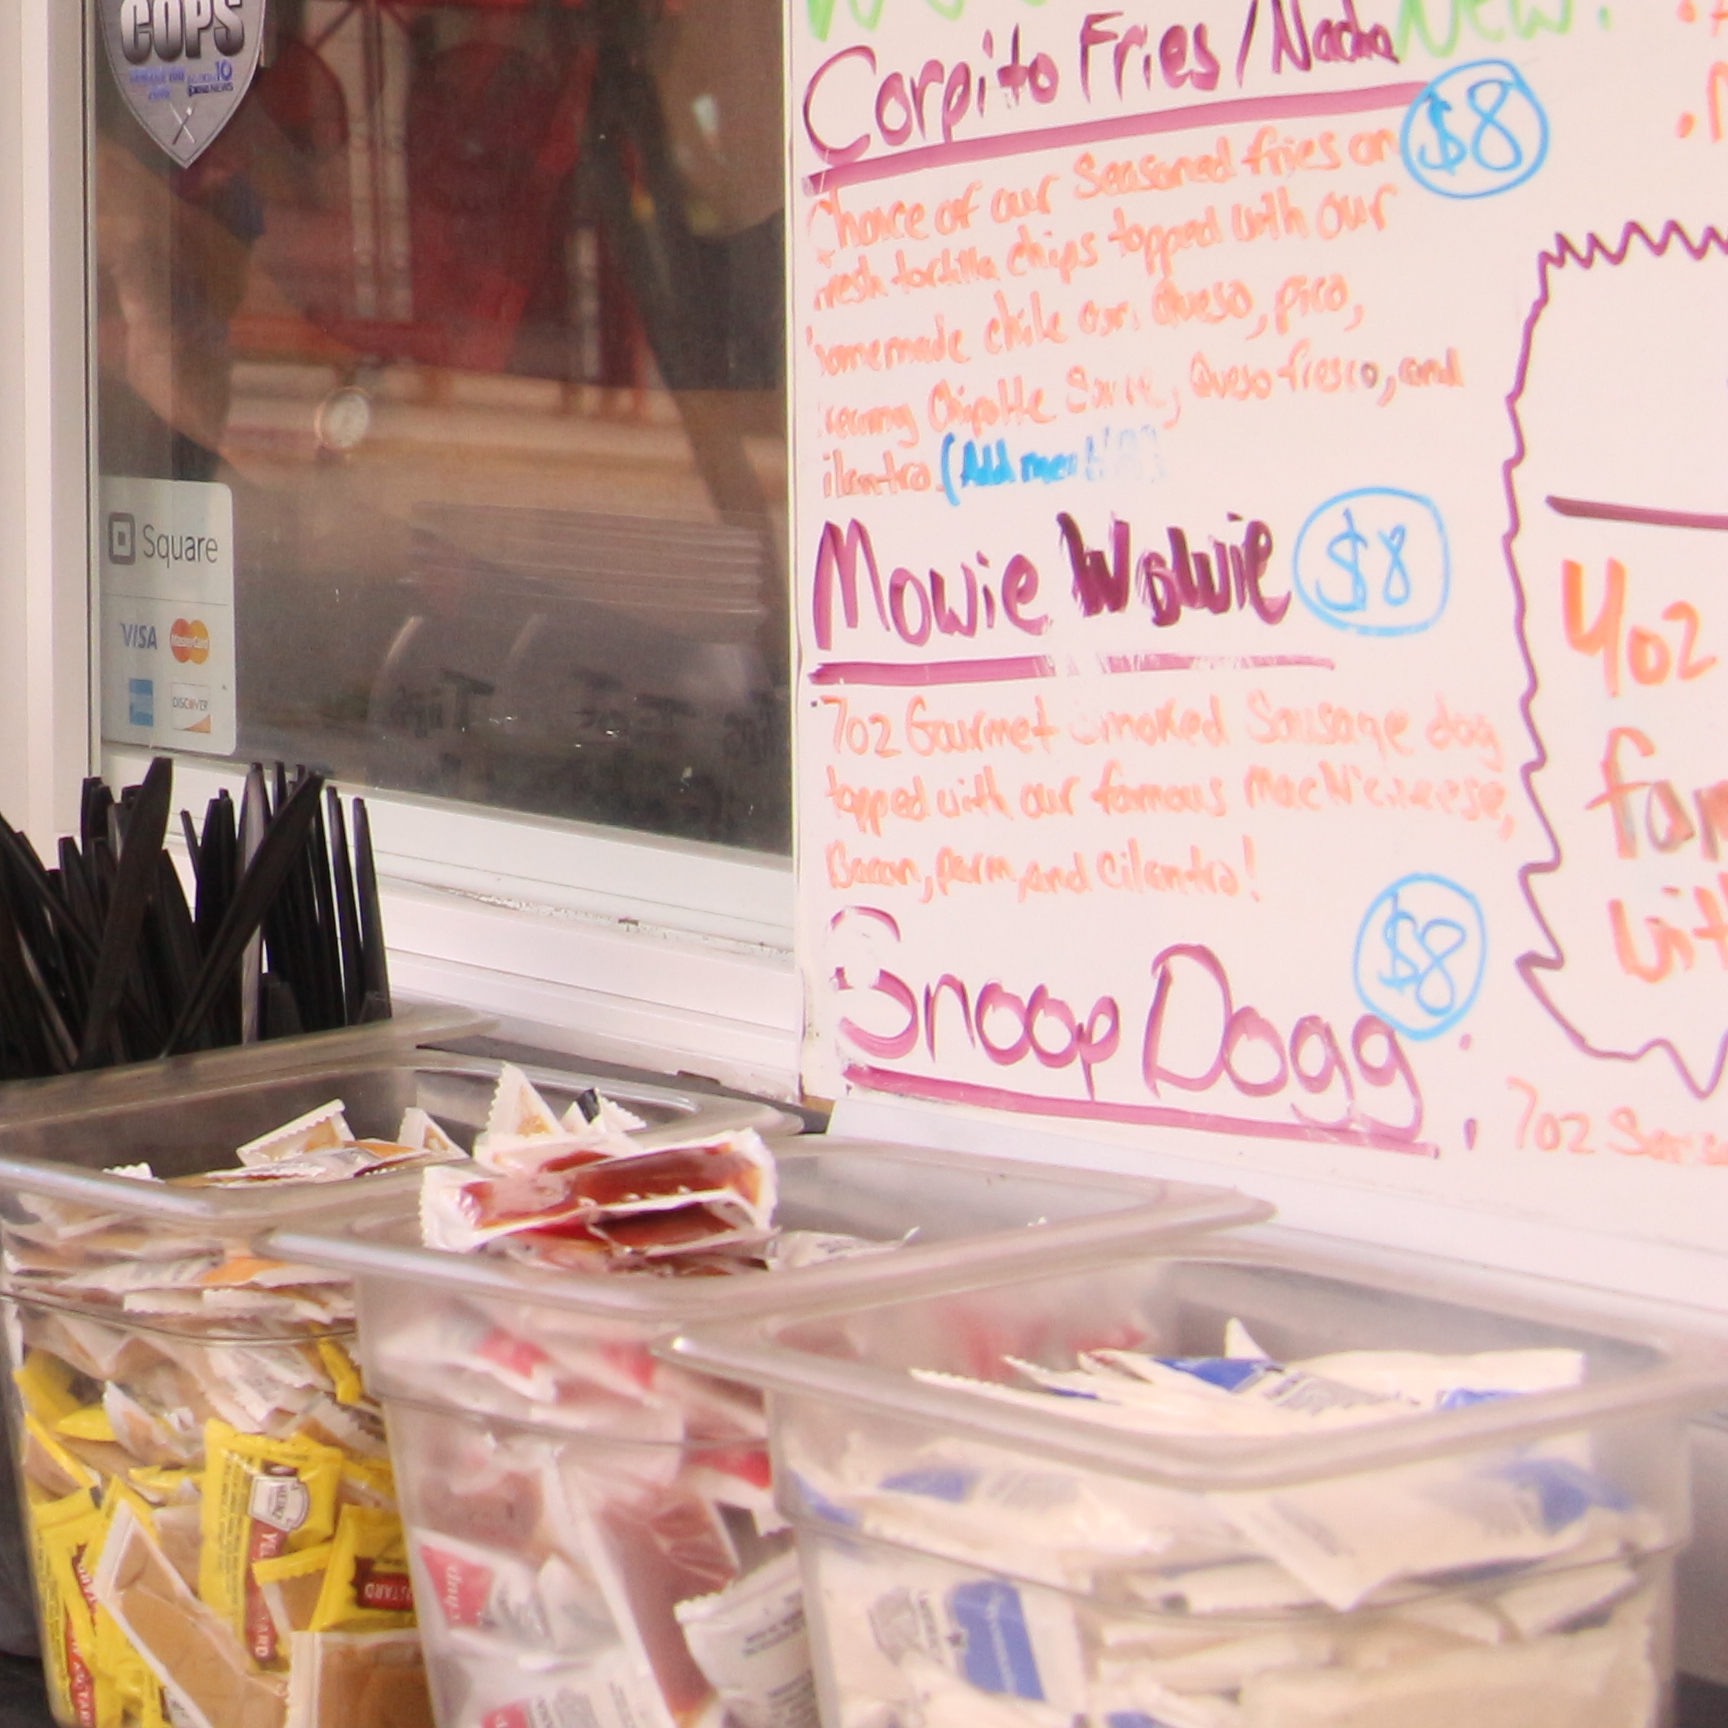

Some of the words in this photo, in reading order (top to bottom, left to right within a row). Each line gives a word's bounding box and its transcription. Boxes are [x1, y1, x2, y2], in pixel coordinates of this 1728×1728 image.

[1418, 76, 1524, 177] $8
[934, 182, 986, 234] of
[990, 173, 1061, 219] our
[1240, 126, 1342, 179] fries
[1005, 224, 1099, 284] chips
[1107, 203, 1224, 276] topped
[1233, 186, 1309, 242] with
[1314, 183, 1399, 239] our
[1398, 348, 1466, 390] and
[142, 523, 219, 569] Square
[1314, 507, 1411, 613] $8
[119, 622, 158, 651] VISA
[170, 634, 210, 649] MasterCard
[1560, 556, 1718, 698] 4oz
[172, 696, 209, 712] DISCOVER
[820, 695, 902, 759] 7oz
[904, 693, 1060, 753] Gourmet
[1425, 695, 1504, 771] dog
[823, 766, 930, 836] topped
[936, 763, 1015, 821] with
[1020, 774, 1079, 820] our
[1095, 762, 1229, 818] famous
[1379, 891, 1467, 1017] $8
[829, 905, 1121, 1100] Snoop
[1144, 942, 1424, 1143] Dogg
[1505, 1074, 1599, 1154] 7oz
